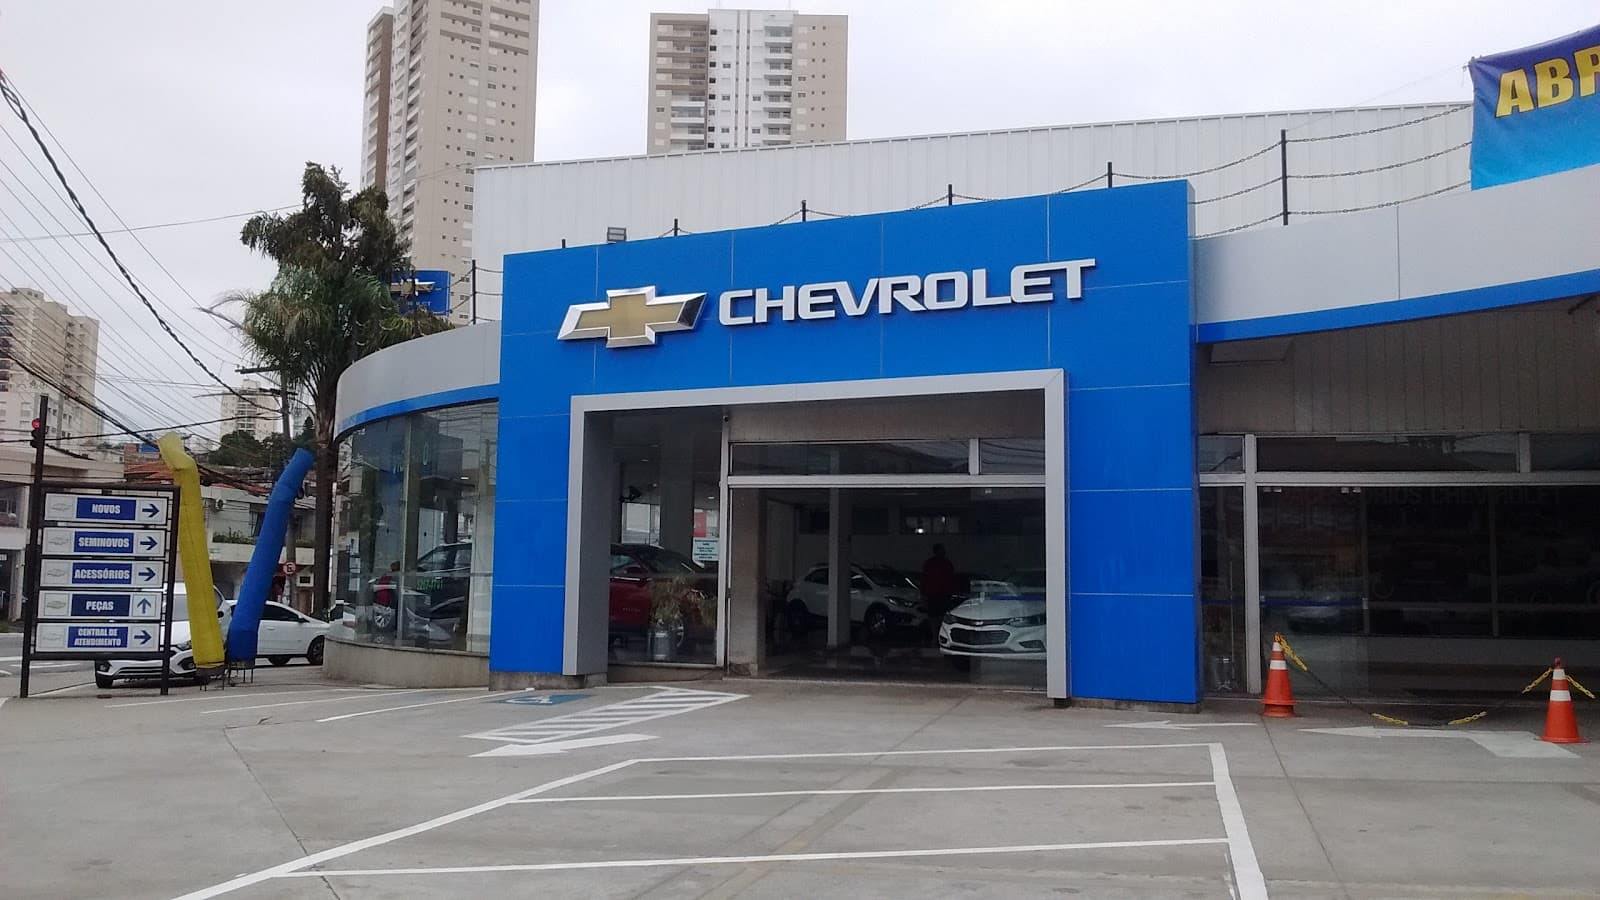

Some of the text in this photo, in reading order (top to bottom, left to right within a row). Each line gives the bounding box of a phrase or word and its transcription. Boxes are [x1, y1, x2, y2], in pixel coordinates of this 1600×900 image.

[719, 257, 1096, 327] CHEVROLET
[91, 503, 121, 514] NOVOS
[78, 537, 130, 548] SEMINOVOS
[74, 567, 130, 580] ACESSÓRIOS
[85, 600, 114, 612] PEÇAS
[78, 628, 118, 637] CENTRAL DE
[73, 637, 122, 646] ATENDIMENTO
